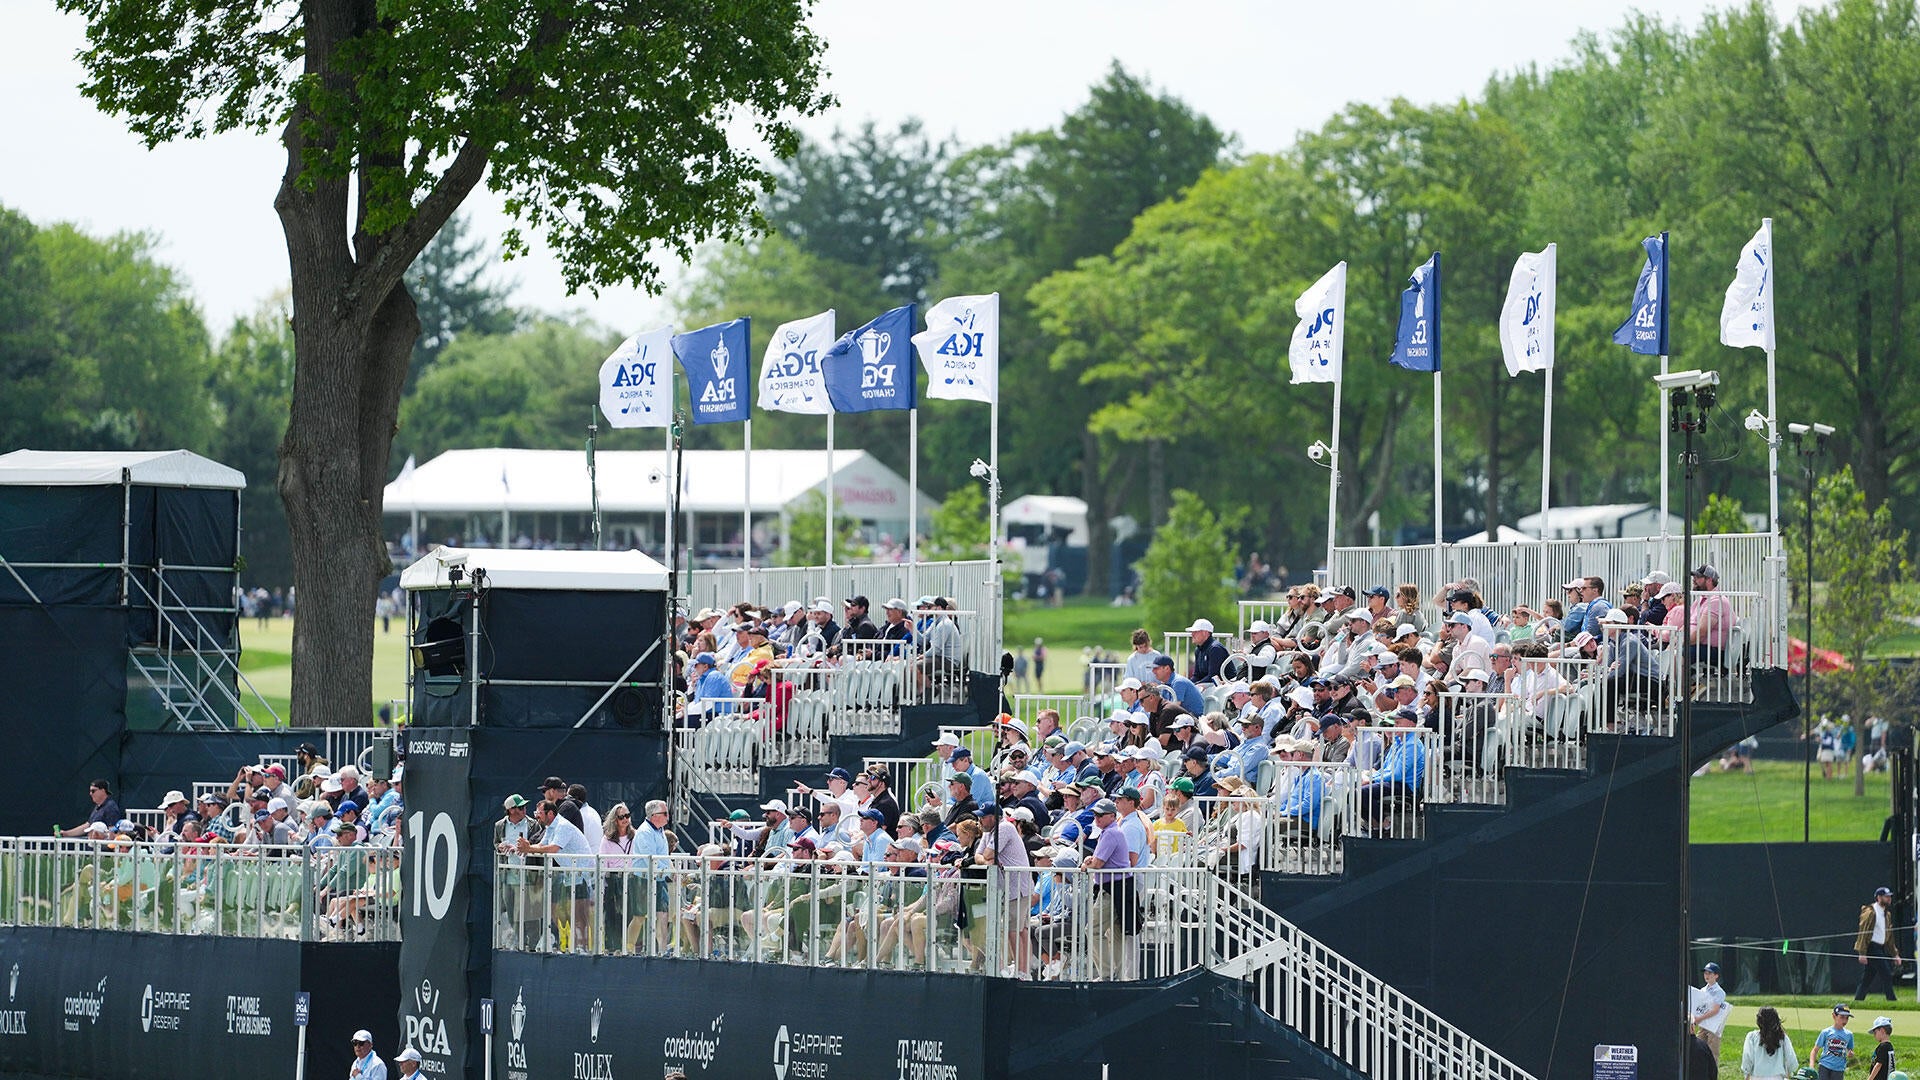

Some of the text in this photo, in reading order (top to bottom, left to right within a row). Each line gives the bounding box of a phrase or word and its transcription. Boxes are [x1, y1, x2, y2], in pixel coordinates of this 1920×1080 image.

[409, 811, 458, 920] 10
[64, 991, 100, 1025] corebridge
[154, 991, 191, 1010] SAPPHIRE
[237, 996, 260, 1015] T-MOBILE
[295, 1003, 308, 1013] PGA
[481, 1003, 492, 1030] 10
[405, 1015, 452, 1055] PGA
[793, 1033, 843, 1056] SAPPHIRE
[507, 1041, 528, 1069] PGA
[664, 1030, 715, 1070] corebridge
[911, 1040, 943, 1062] T-MOBILE
[420, 1060, 446, 1074] AMERICA
[573, 1052, 614, 1080] ROLEX
[909, 1063, 958, 1080] FOR BUSINESS
